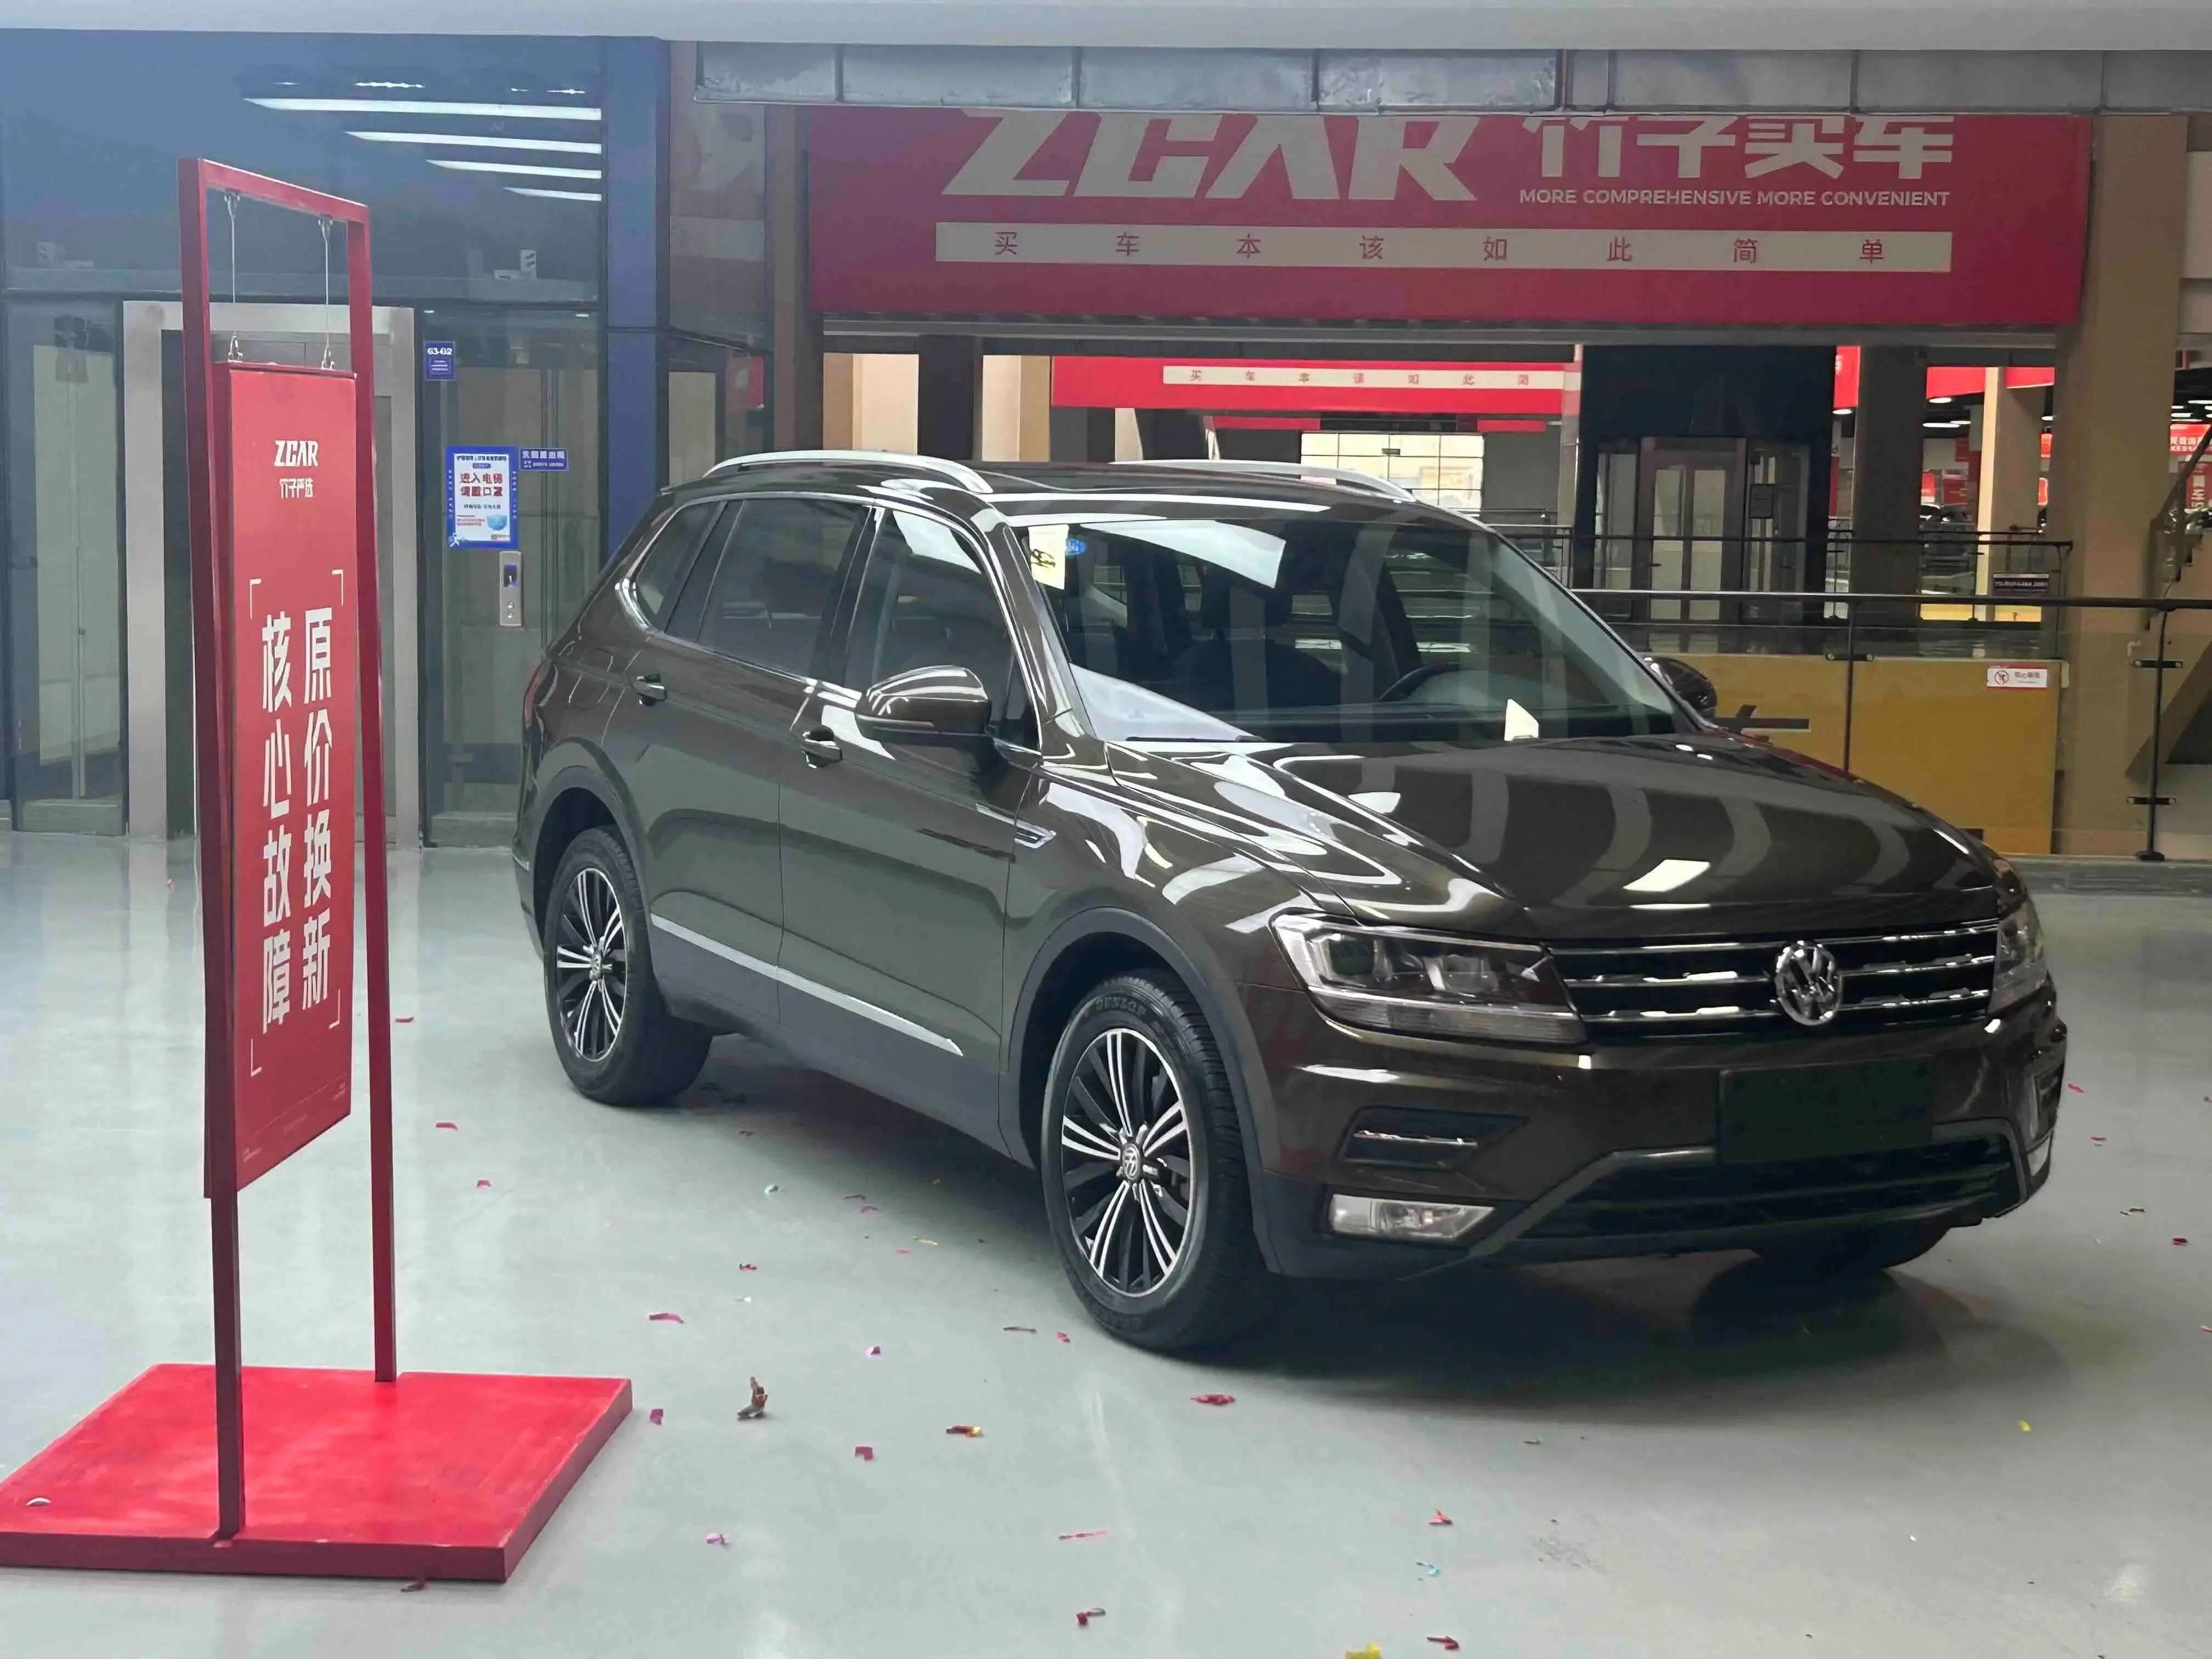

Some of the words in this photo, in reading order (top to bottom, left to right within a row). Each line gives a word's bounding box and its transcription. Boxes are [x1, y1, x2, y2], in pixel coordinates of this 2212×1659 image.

[941, 111, 1481, 201] ZCAR
[1522, 116, 1955, 179] 竹子买车
[1519, 189, 1577, 204] MORE
[1583, 189, 1752, 206] COMPREHENSIVE
[1757, 190, 1816, 206] MORE
[1821, 190, 1950, 207] CONVENIENT
[995, 232, 1884, 264] 买车本该如此简单
[274, 440, 318, 467] ZCAR
[262, 611, 292, 1034] 核心故障
[302, 607, 332, 1009] 原价换新
